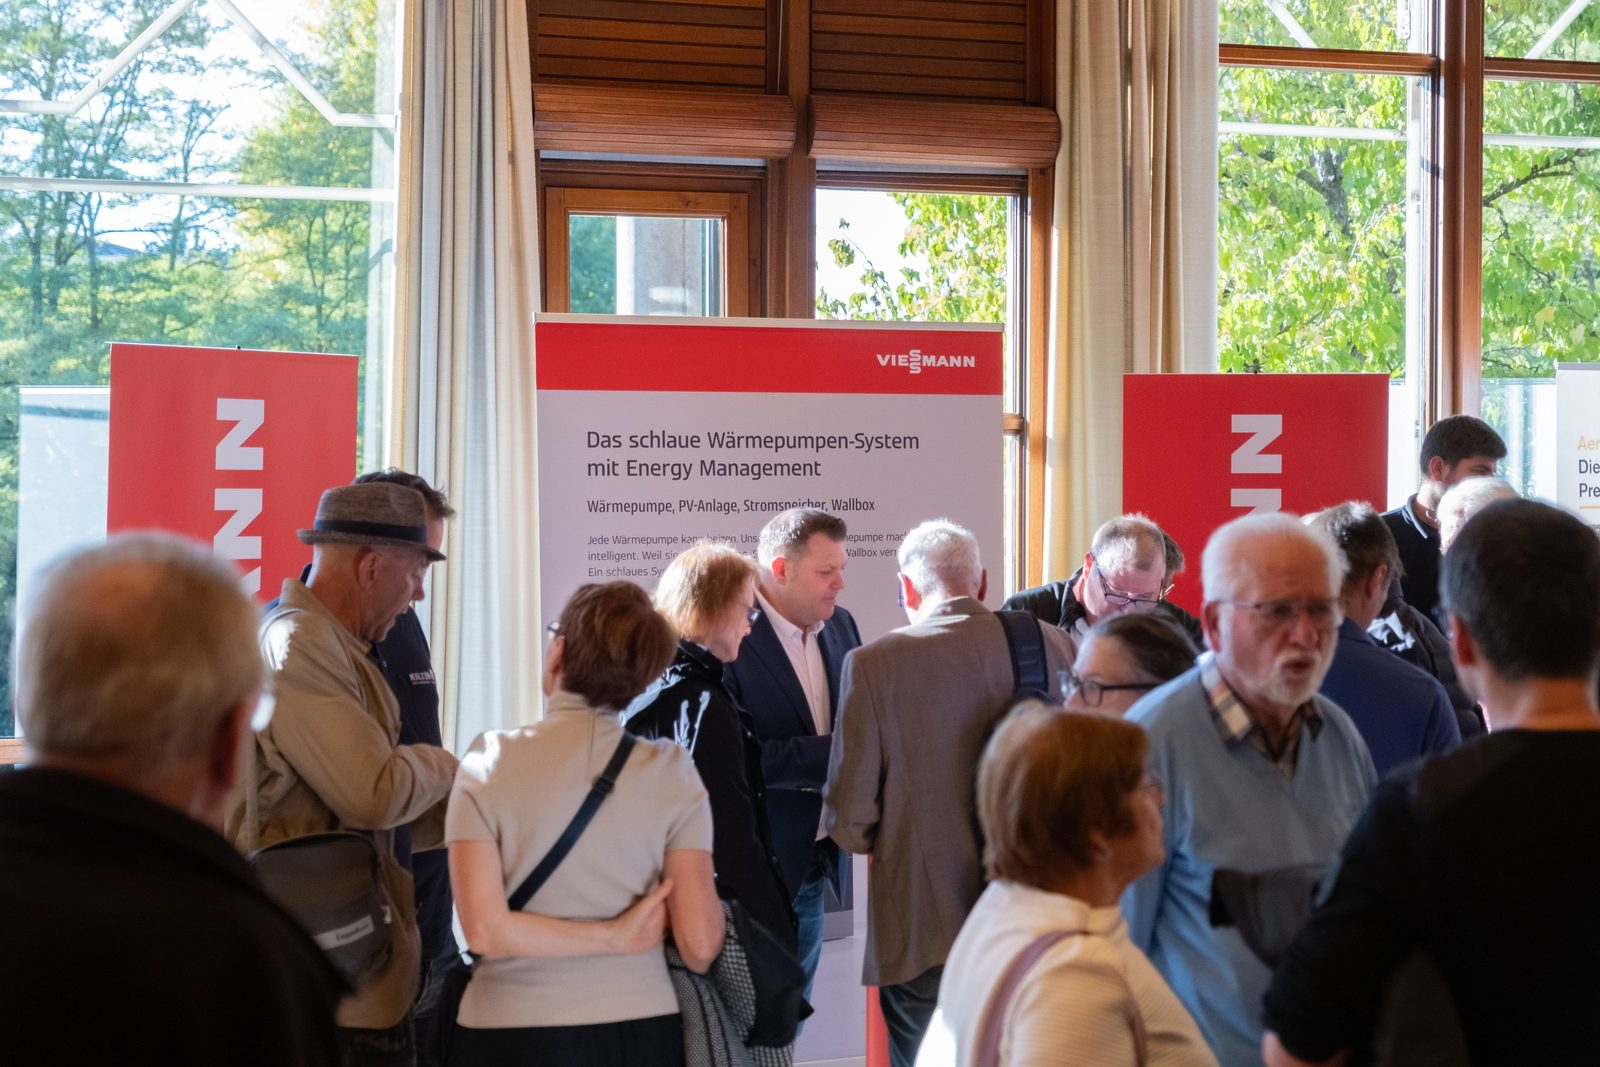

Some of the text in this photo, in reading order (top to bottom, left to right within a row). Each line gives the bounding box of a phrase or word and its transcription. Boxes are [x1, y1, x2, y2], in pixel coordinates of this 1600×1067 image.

[876, 349, 976, 374] VIESSMANN
[587, 430, 919, 453] Das schlaue Wärmepumpen-System
[587, 458, 821, 480] mit Energy Management
[587, 500, 675, 515] Wärmepumpe,
[679, 499, 740, 514] PV-Anlage,
[831, 498, 875, 511] Wallbox
[588, 535, 610, 545] Jede
[612, 534, 679, 546] Wärmepumpe
[588, 551, 639, 563] intelligent.
[641, 550, 662, 560] Weil
[588, 567, 603, 577] Ein
[606, 566, 649, 577] schlaues
